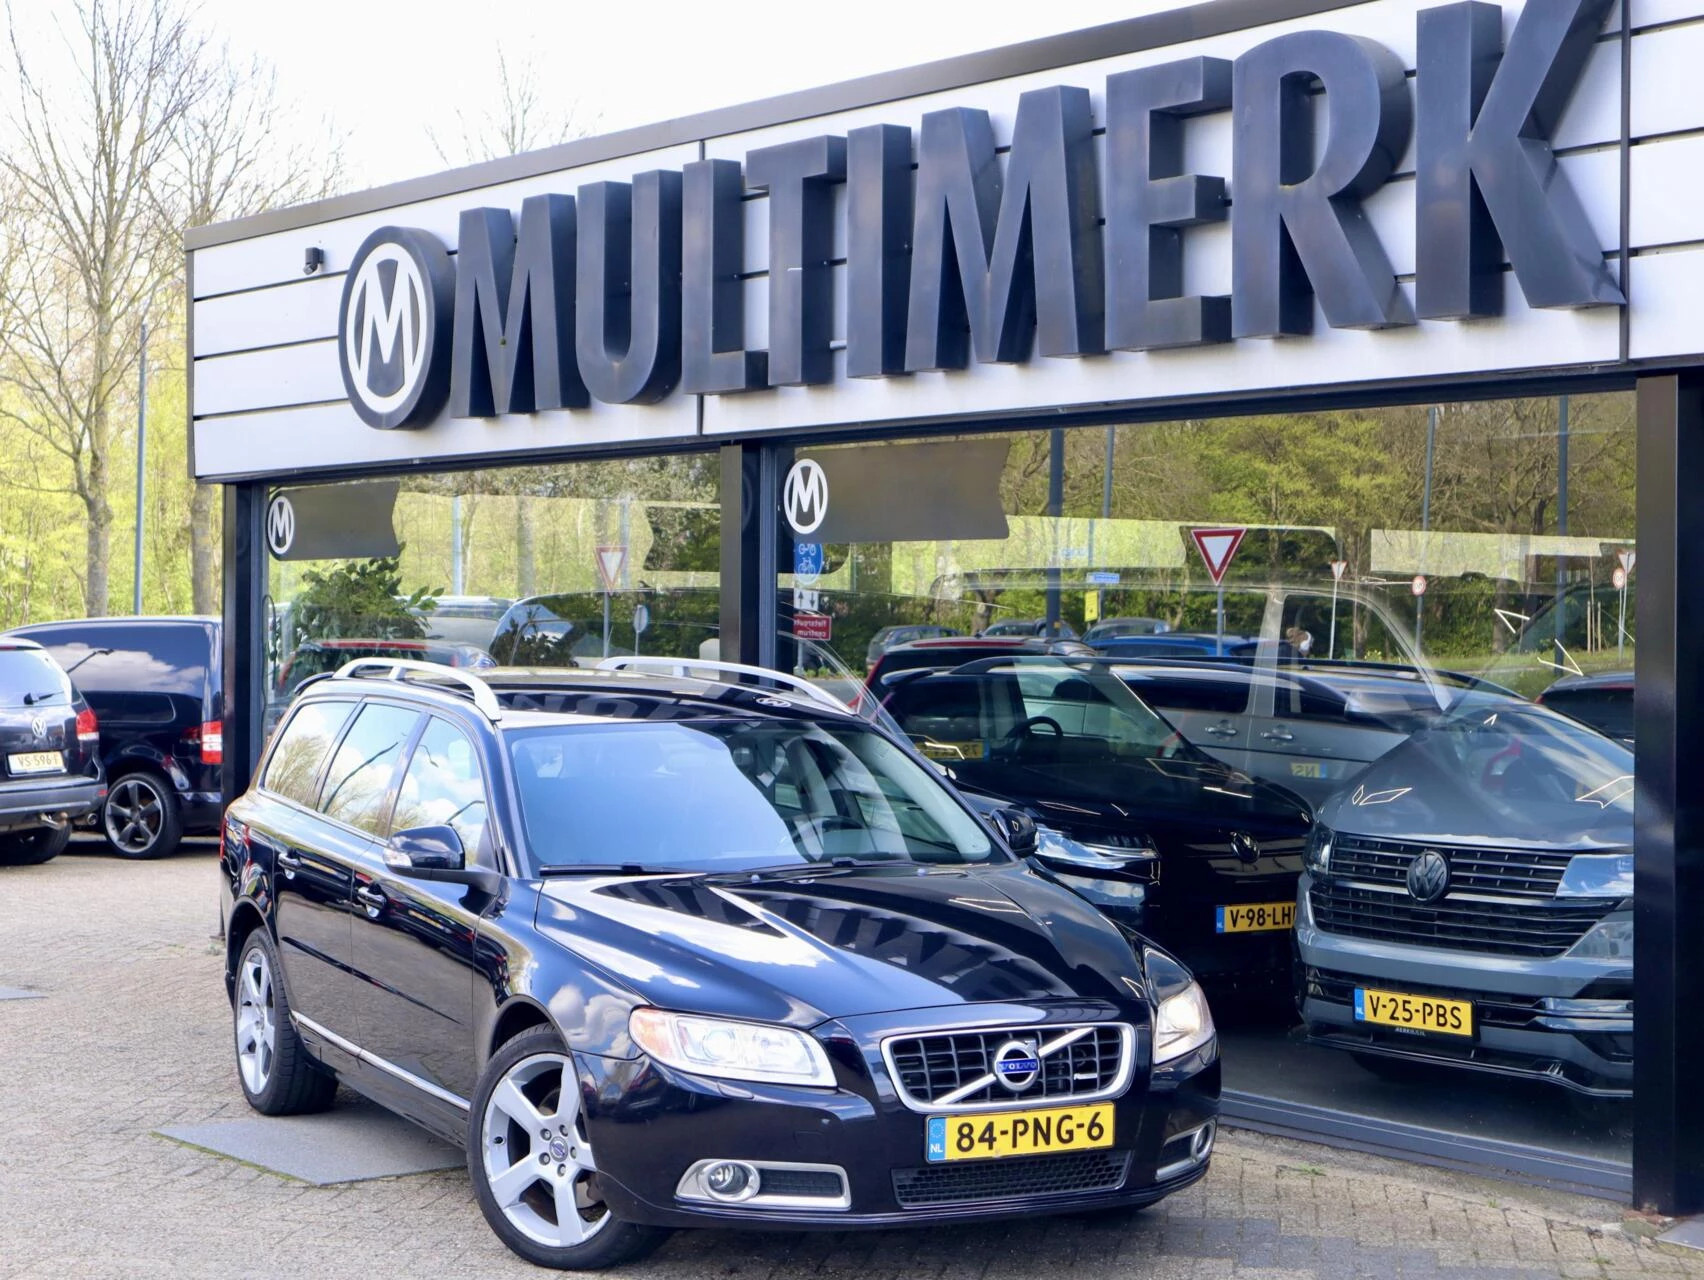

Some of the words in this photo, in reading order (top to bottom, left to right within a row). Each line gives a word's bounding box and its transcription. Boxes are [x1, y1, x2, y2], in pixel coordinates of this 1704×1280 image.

[450, 0, 1627, 419] MULTIMERK
[1230, 905, 1296, 928] V-98-LH
[1369, 994, 1463, 1029] V-25-PBS
[998, 1061, 1037, 1071] VOLVO
[930, 1143, 943, 1153] NL
[955, 1111, 1105, 1153] 84-PNG-6
